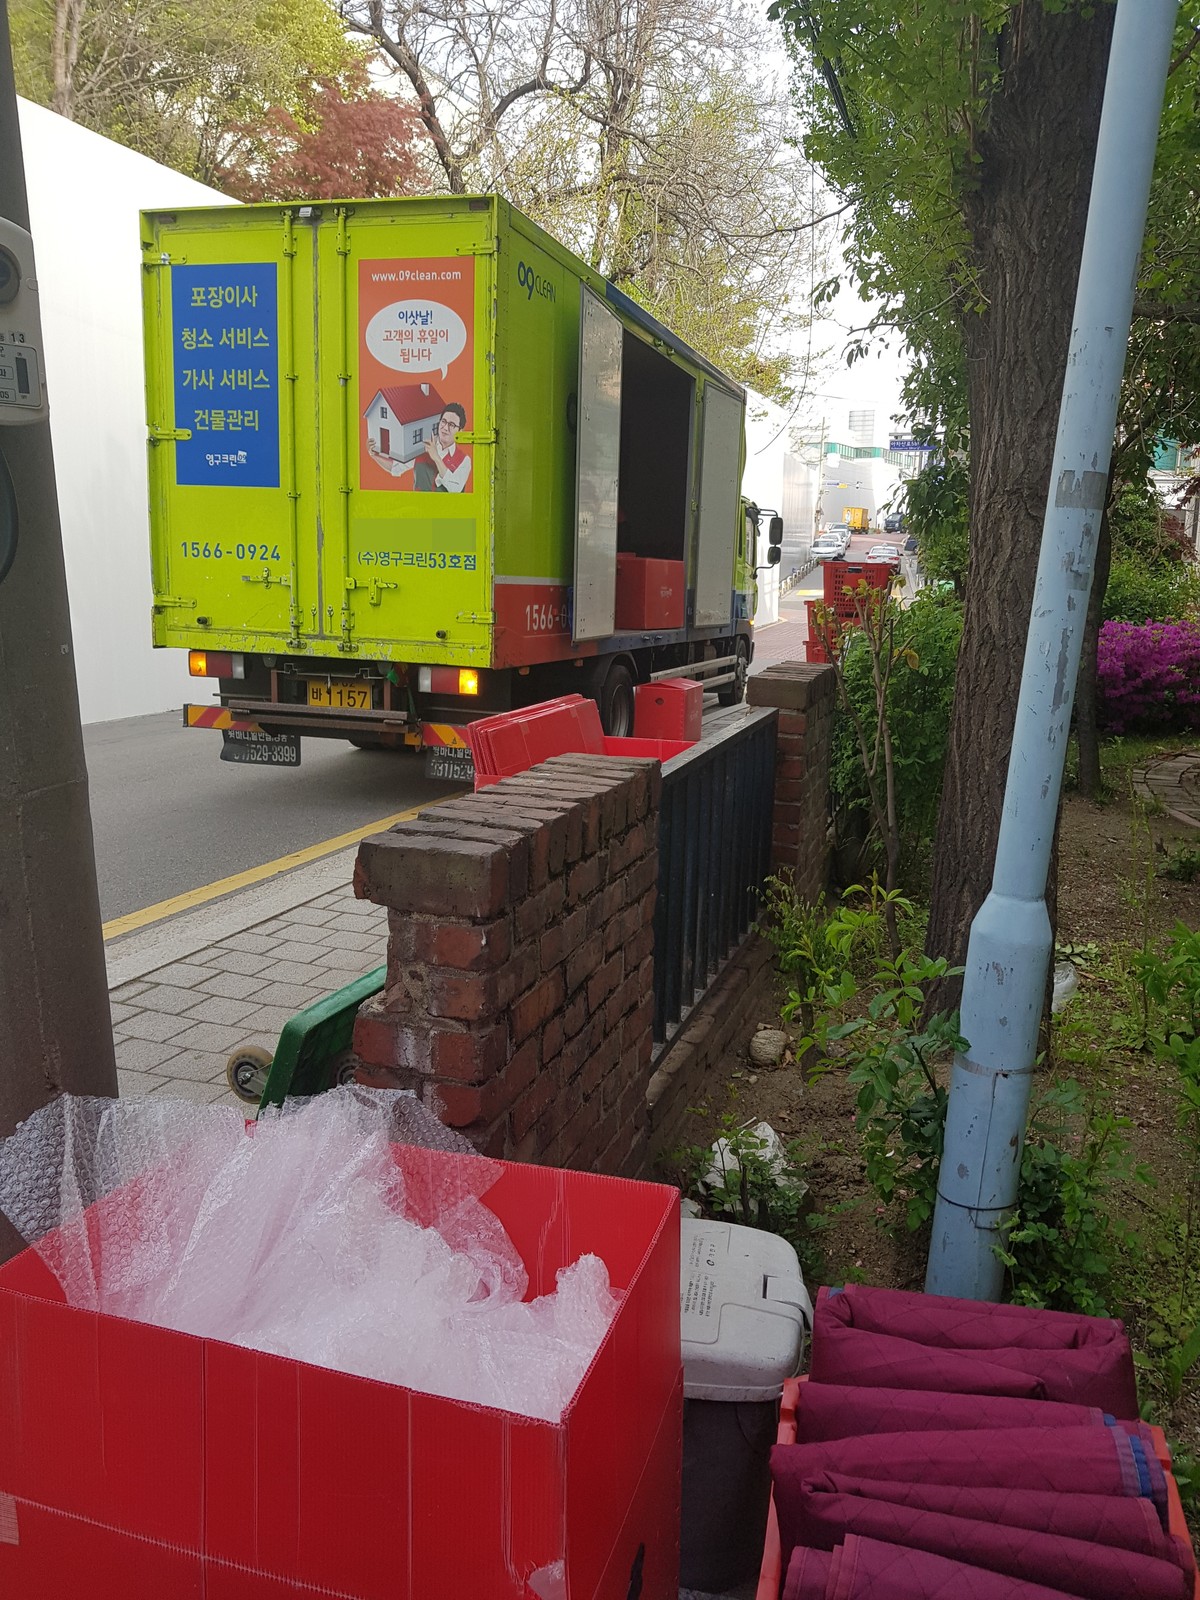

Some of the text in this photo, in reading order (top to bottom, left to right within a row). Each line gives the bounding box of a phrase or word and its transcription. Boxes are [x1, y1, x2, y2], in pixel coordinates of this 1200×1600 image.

[371, 270, 461, 282] www.09clean.com
[190, 285, 258, 308] 포장이사
[398, 310, 433, 326] 이삿날!
[181, 327, 270, 350] 청소 서비스
[382, 329, 449, 344] 고객의 휴일이
[400, 348, 432, 363] 됩니다
[182, 369, 270, 390] 가사 서비스
[194, 409, 259, 431] 건물관리
[181, 541, 281, 561] 1566-0924
[358, 551, 477, 571] (수)영구크린53호점
[311, 687, 368, 708] 바 1157
